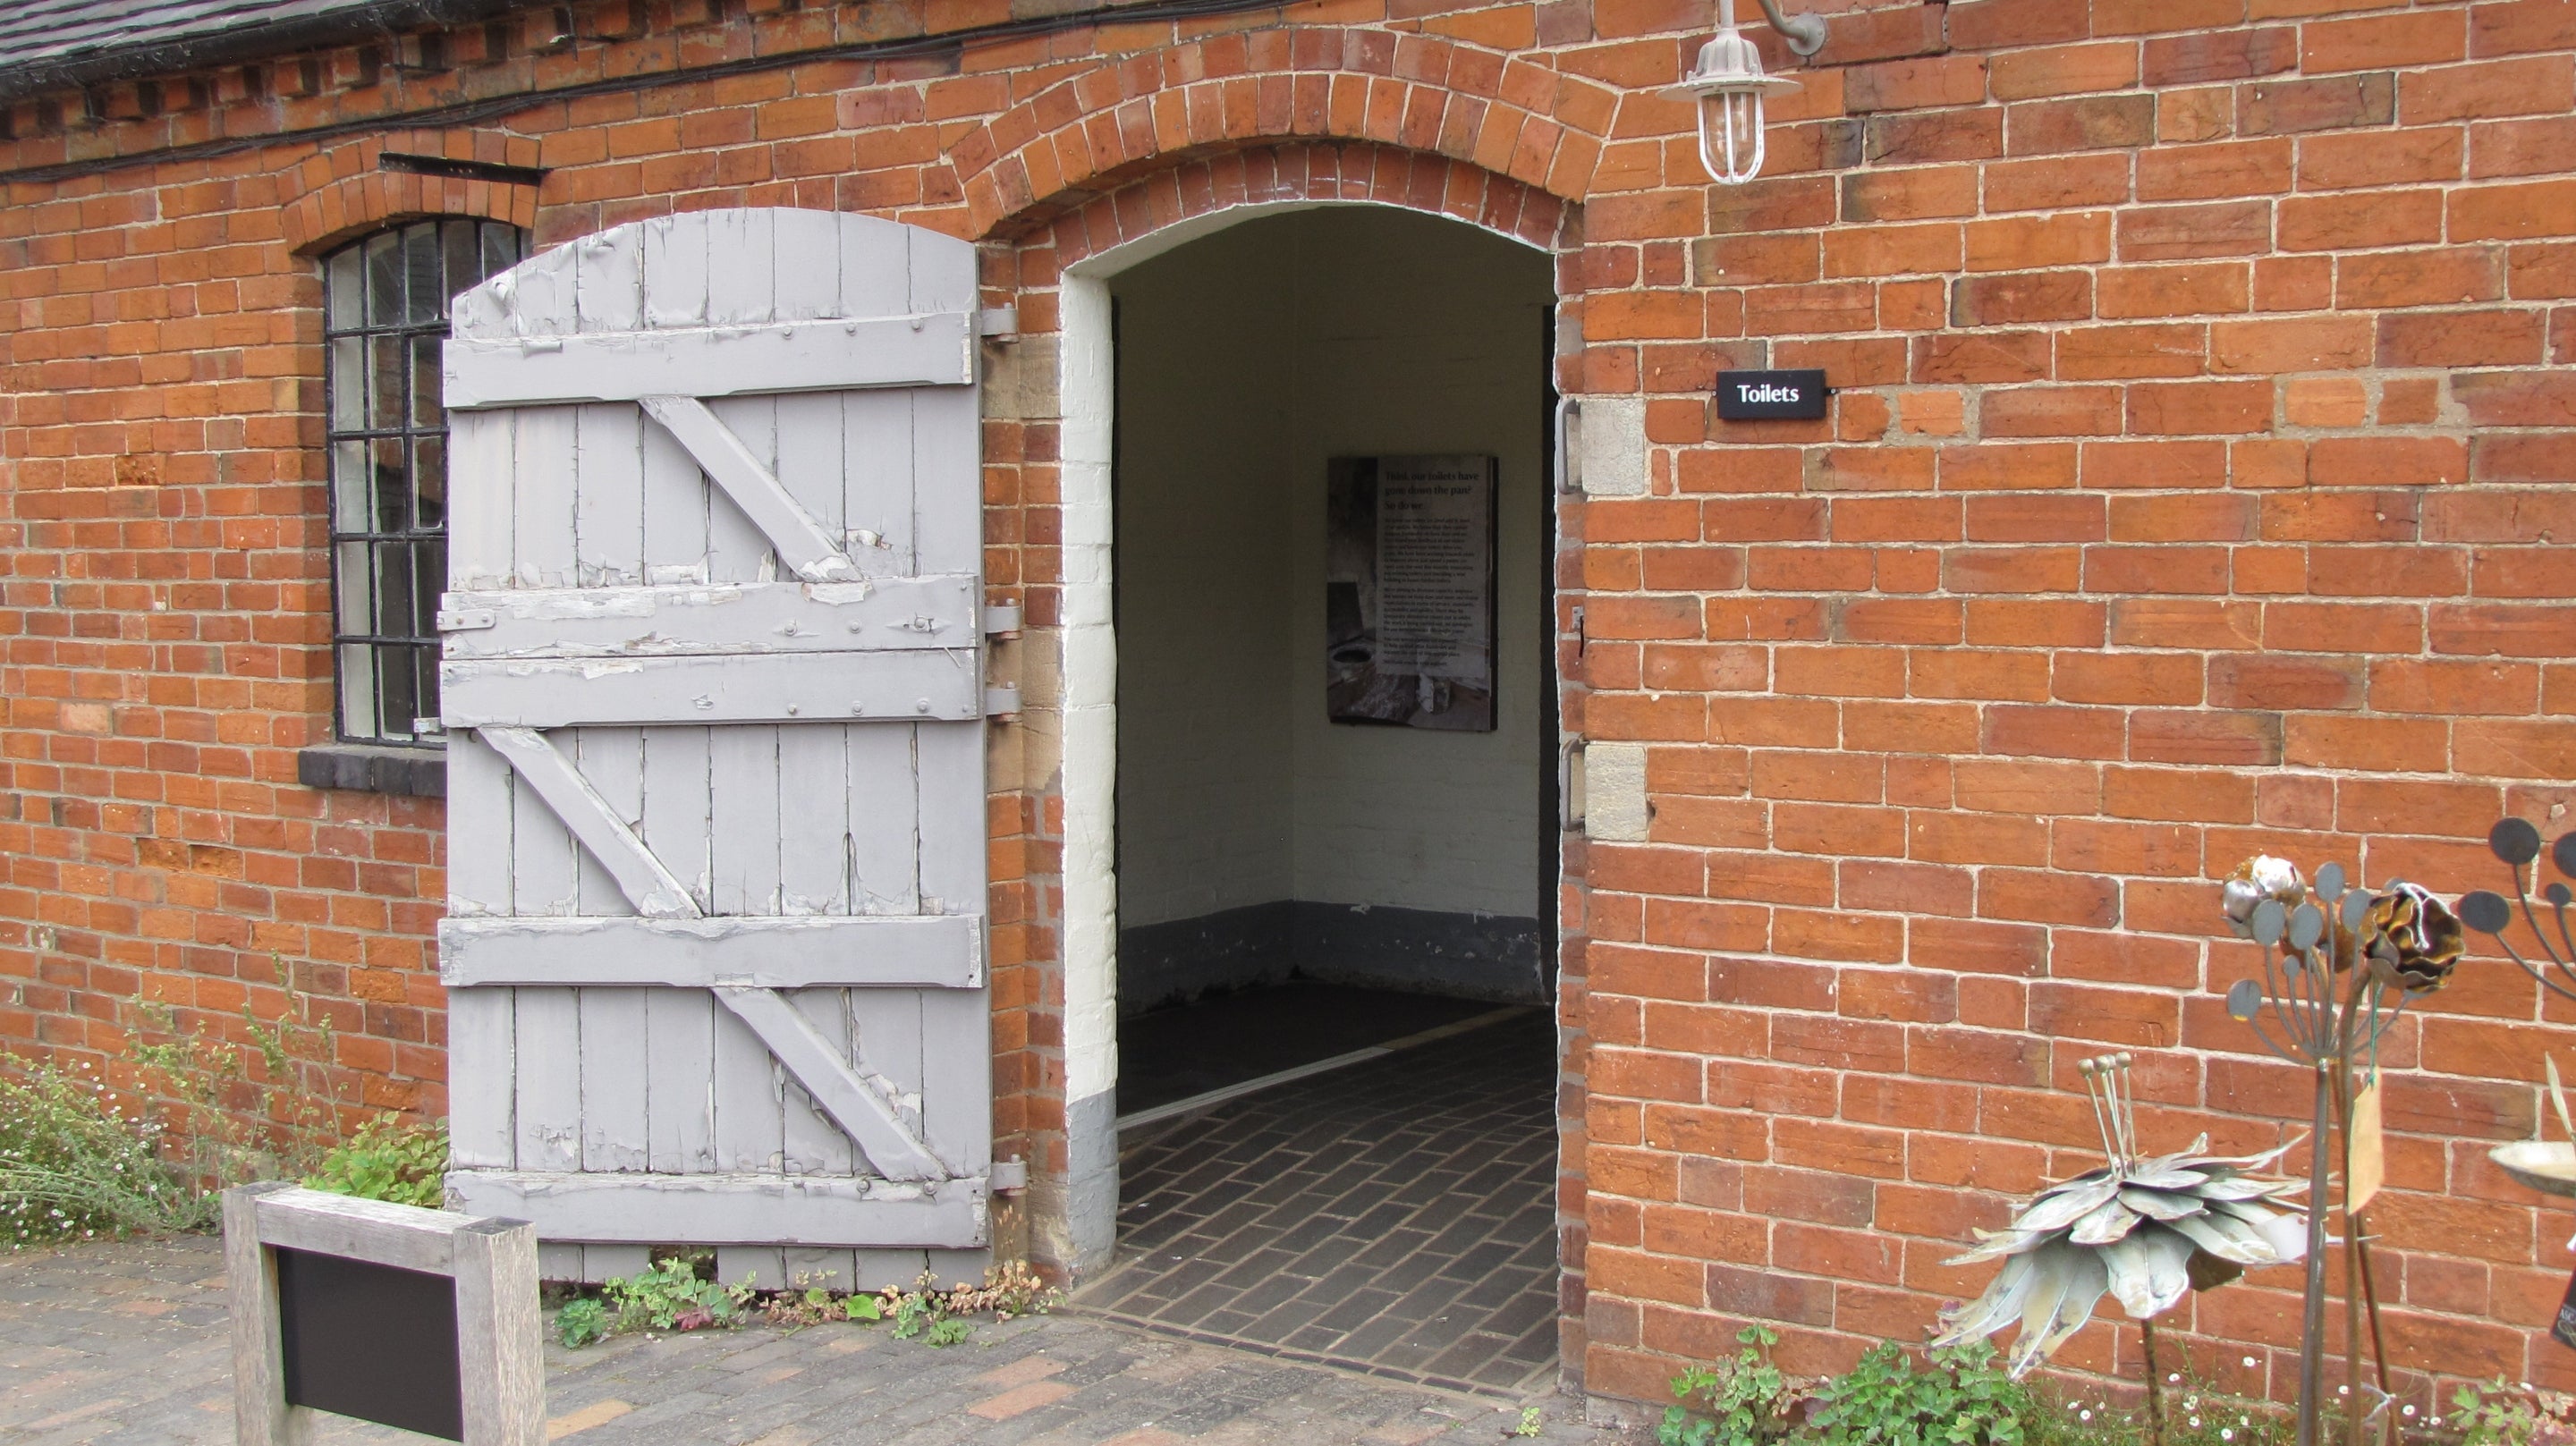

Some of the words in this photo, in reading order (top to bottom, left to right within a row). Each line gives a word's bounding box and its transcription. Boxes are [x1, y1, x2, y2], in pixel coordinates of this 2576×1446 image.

[1736, 384, 1800, 402] Toilets
[1458, 471, 1479, 480] have
[1434, 486, 1449, 495] the
